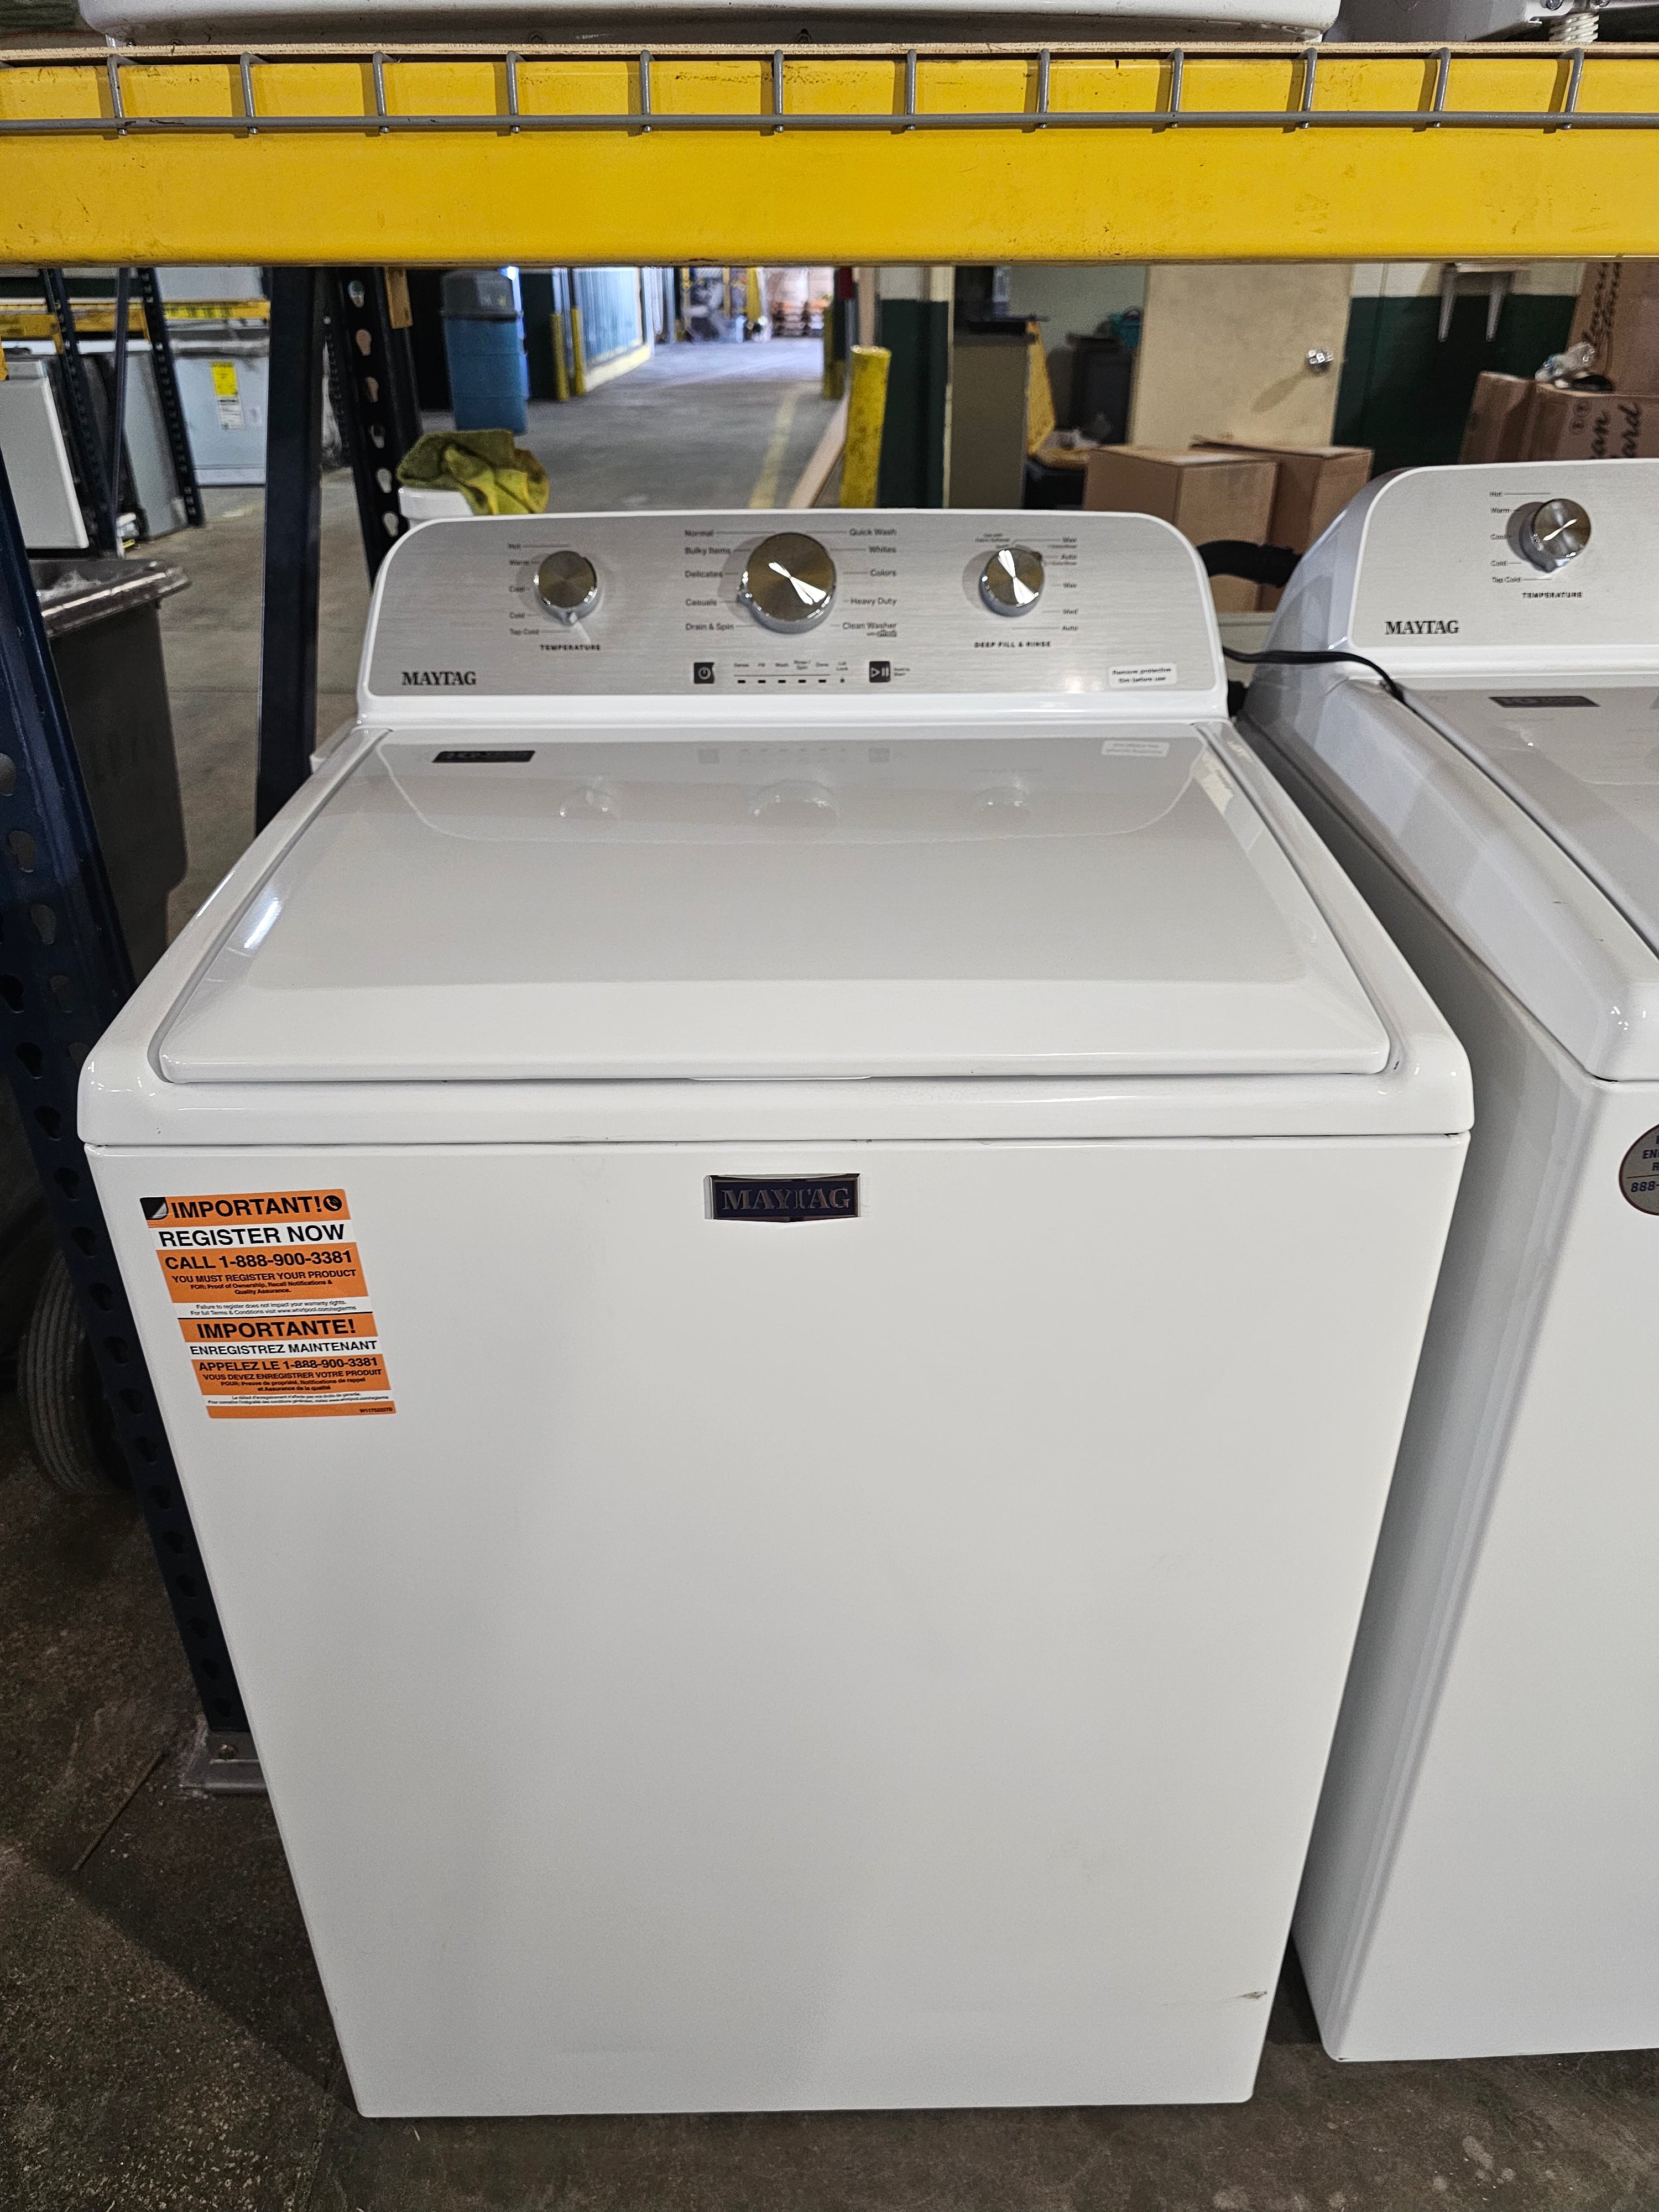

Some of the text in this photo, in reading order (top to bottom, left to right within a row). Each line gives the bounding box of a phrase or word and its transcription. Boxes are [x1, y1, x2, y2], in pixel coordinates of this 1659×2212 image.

[849, 528, 897, 536] Quick Wash
[685, 546, 707, 556] Bulky
[869, 568, 897, 577] Colors
[851, 597, 897, 607] Heavy Duty
[708, 623, 714, 631] &
[716, 623, 735, 632] Spin
[842, 622, 865, 630] Clean
[1385, 620, 1460, 635] MAYTAG
[401, 671, 477, 686] MAYTAG
[721, 1187, 851, 1211] MAYTAG
[171, 1195, 322, 1219] IMPORTANT!
[158, 1223, 345, 1248] REGISTER NOW
[165, 1250, 353, 1270] CALL 1-888-900-3381
[172, 1269, 357, 1284] YOU MUST REGISTER YOUR PRODUCT
[196, 1318, 356, 1338] IMPORTANTE!
[190, 1340, 378, 1355] ENREGISTREZ MAINTENANT
[199, 1357, 378, 1371] APPELEZ LE 1-888-900-3381
[257, 1371, 315, 1380] ENREGISTRER
[345, 1369, 382, 1377] PRODUIT
